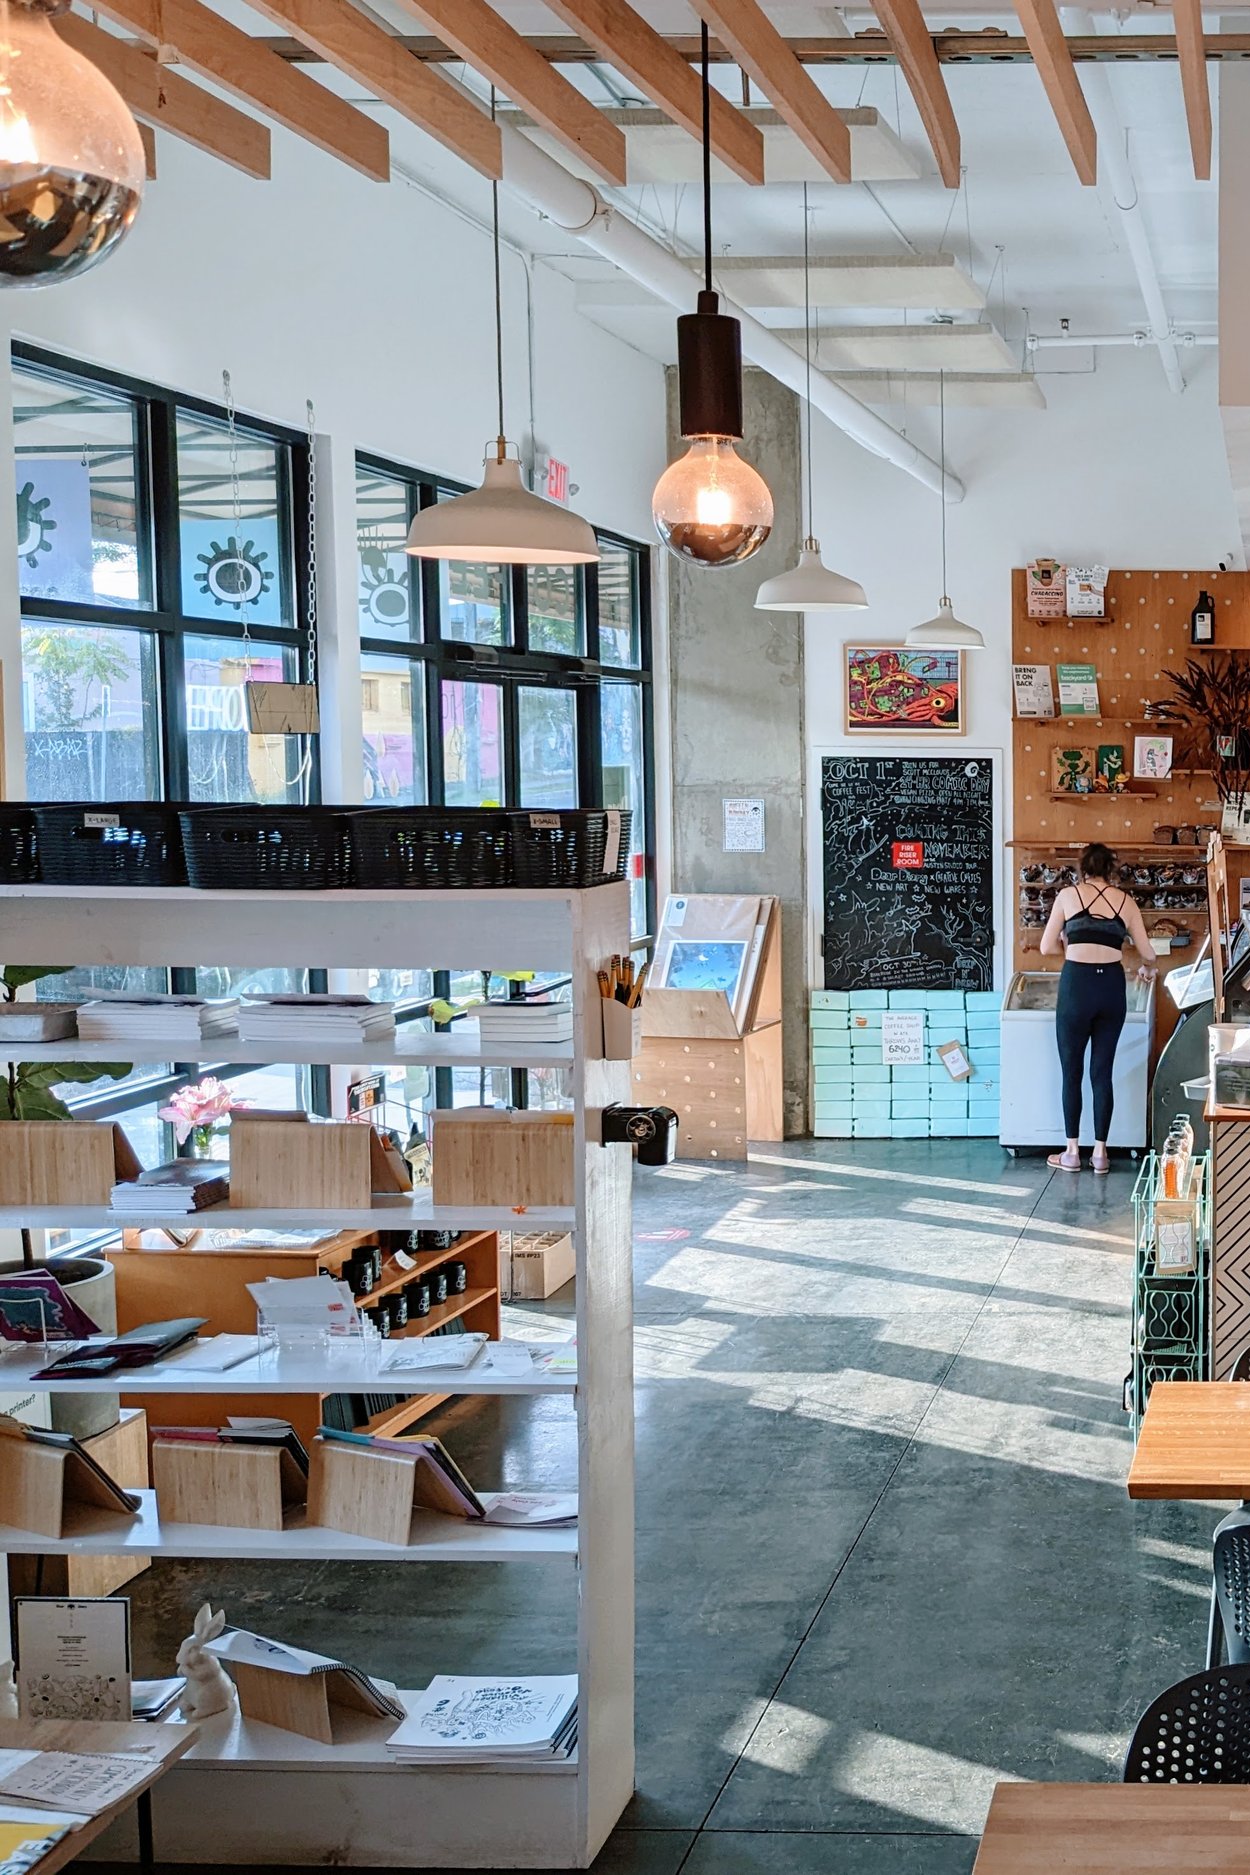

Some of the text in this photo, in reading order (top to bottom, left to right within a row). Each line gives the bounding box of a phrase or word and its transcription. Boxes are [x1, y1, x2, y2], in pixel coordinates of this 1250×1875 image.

[549, 459, 567, 501] EXIT
[830, 762, 869, 779] OCT
[832, 786, 870, 796] COFFEE FEST
[932, 776, 967, 791] COMIC
[952, 824, 987, 842] THIS
[876, 883, 893, 891] NEW
[896, 883, 908, 891] ART
[925, 885, 940, 893] NEW
[889, 1045, 910, 1053] 6240
[9, 1393, 36, 1416] printer?
